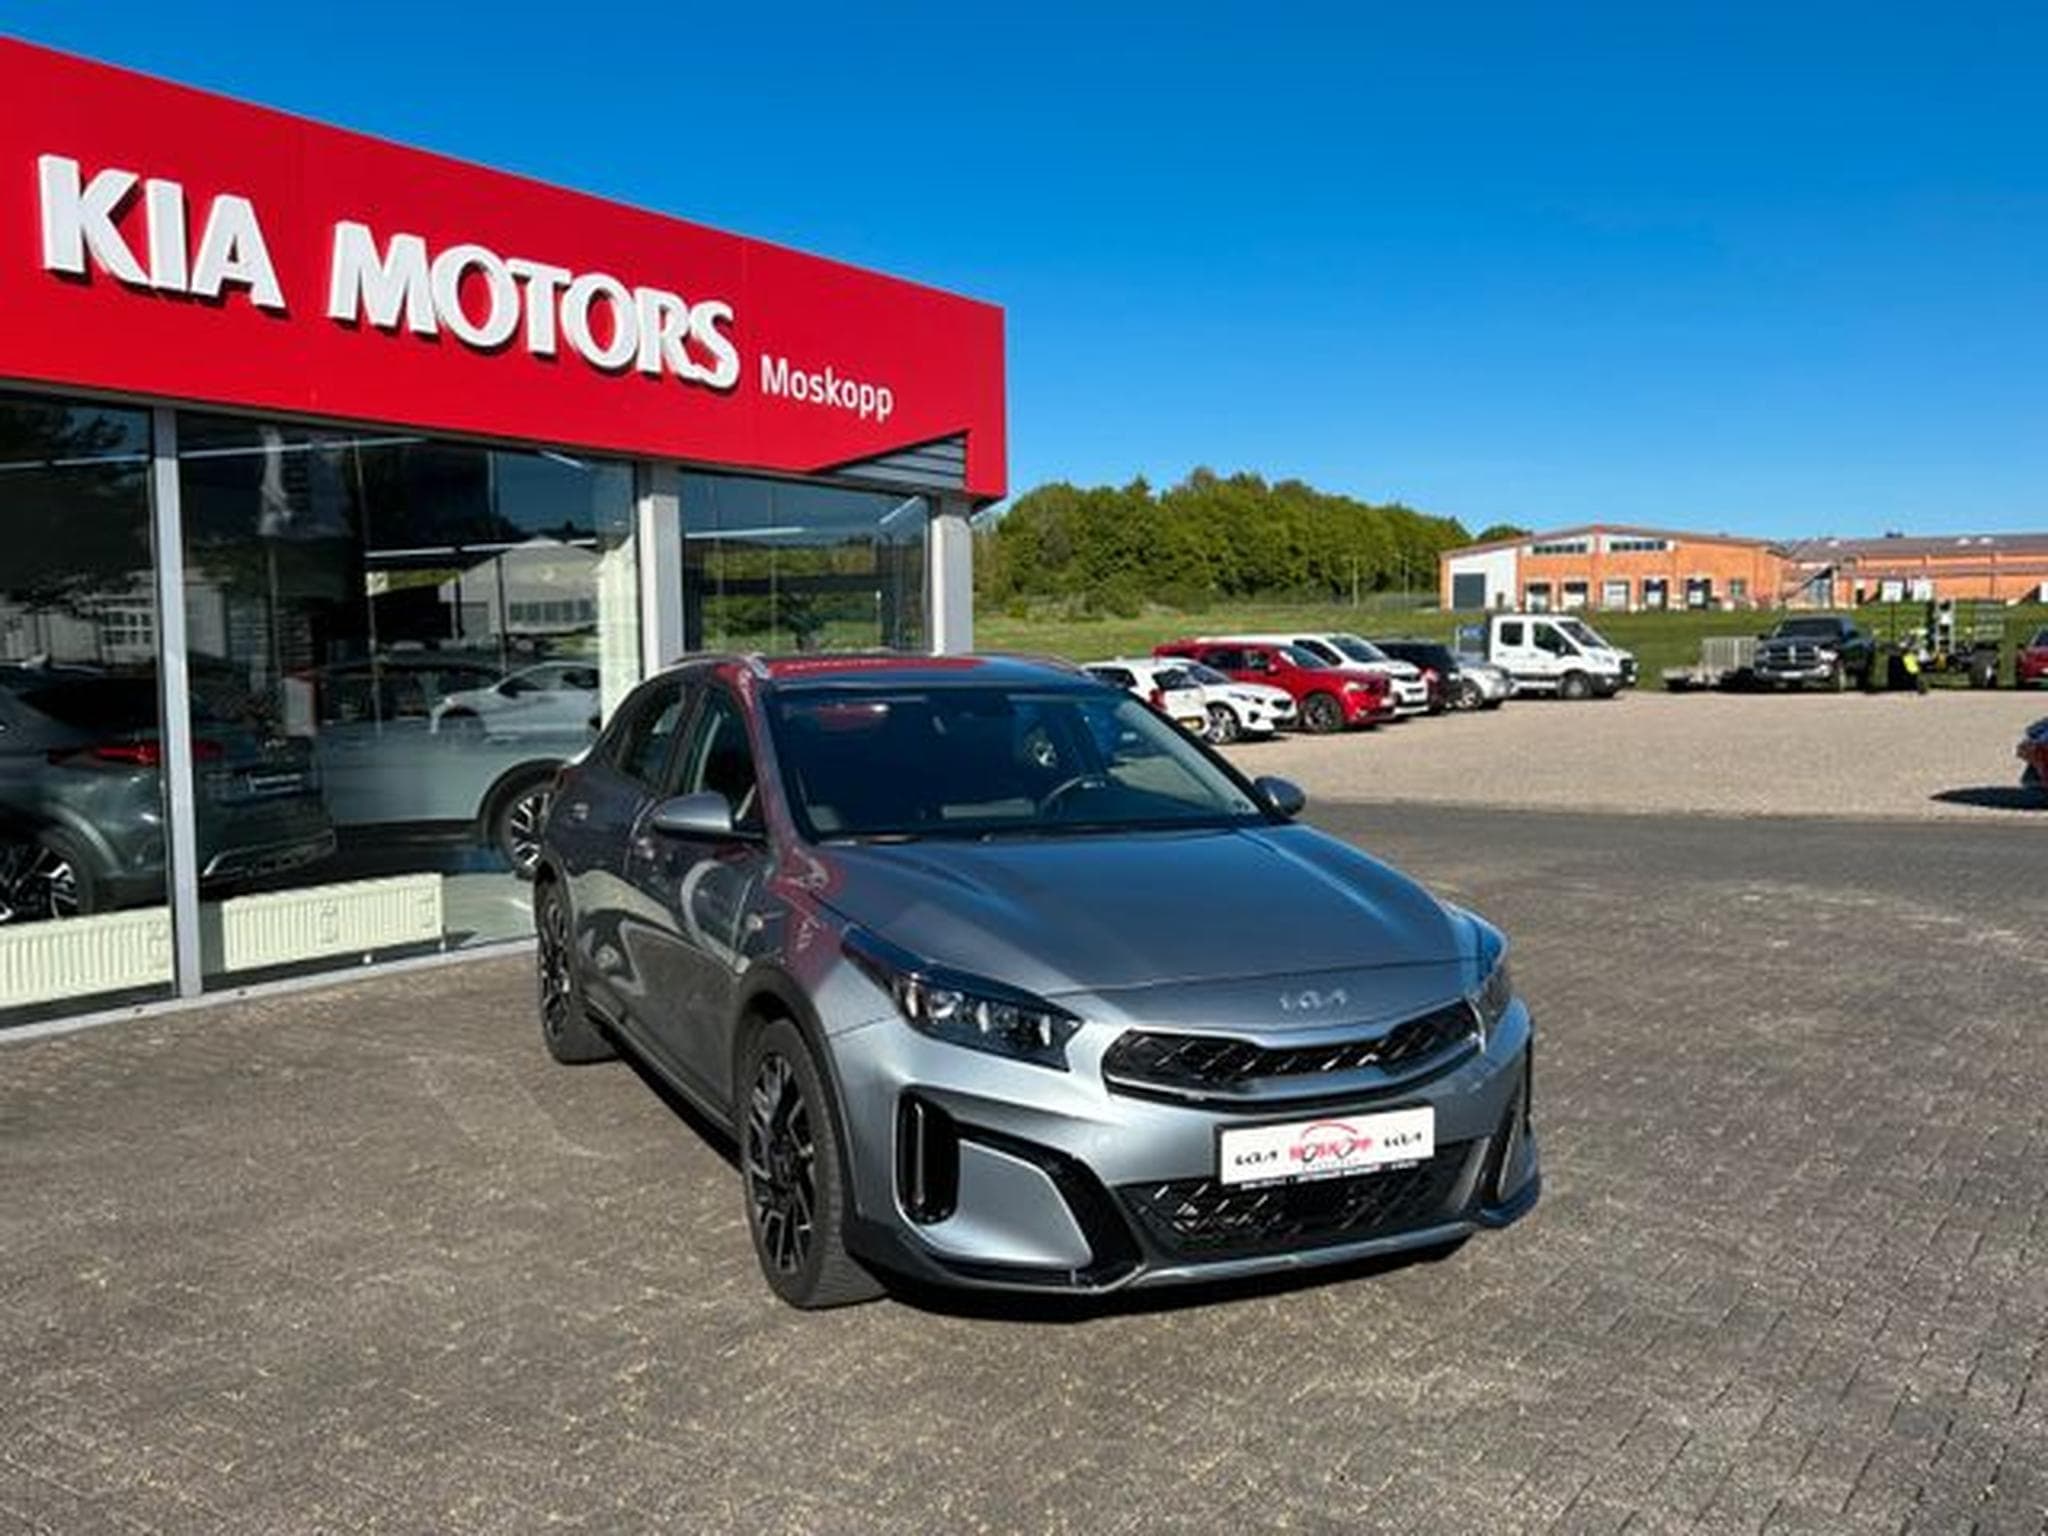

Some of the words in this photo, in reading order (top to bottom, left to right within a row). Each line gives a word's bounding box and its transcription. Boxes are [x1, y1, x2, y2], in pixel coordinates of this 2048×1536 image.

[38, 154, 286, 309] KIA
[328, 220, 741, 389] MOTORS
[761, 354, 893, 422] Moskopp
